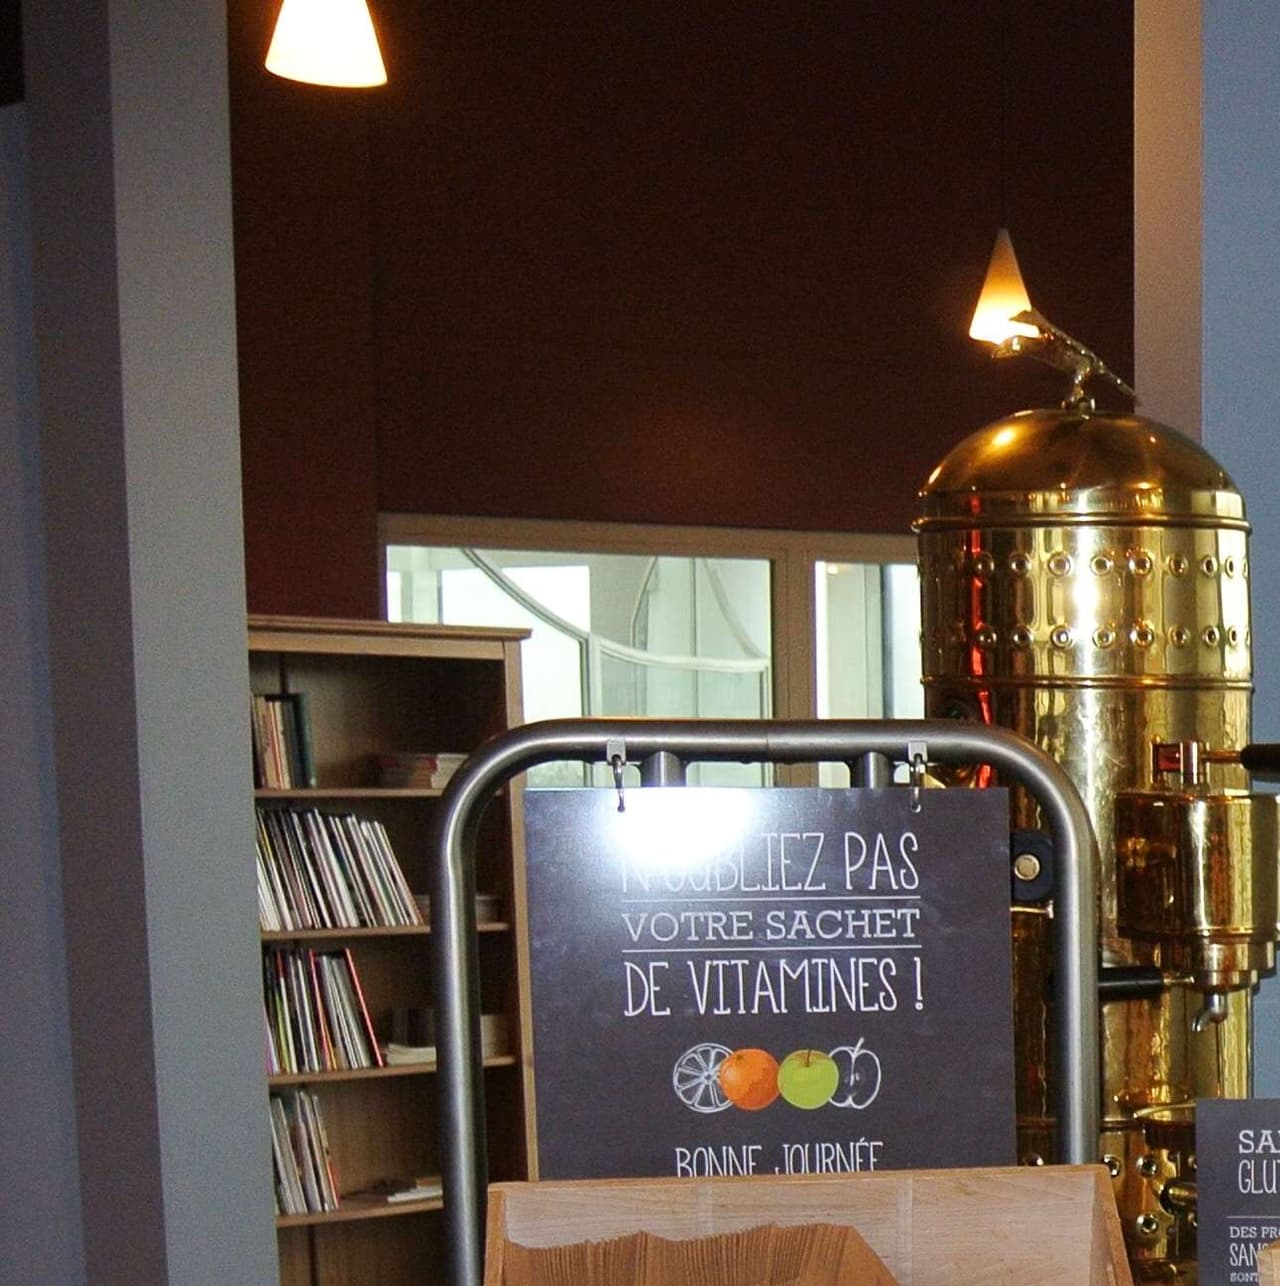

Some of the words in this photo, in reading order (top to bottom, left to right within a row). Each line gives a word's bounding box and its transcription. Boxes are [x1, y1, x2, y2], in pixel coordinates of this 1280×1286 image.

[845, 831, 919, 890] PAS
[623, 911, 753, 942] VOTRE
[767, 908, 920, 940] SACHET
[623, 961, 671, 1017] DE
[687, 958, 898, 1015] VITAMINES
[914, 957, 924, 1011] !
[675, 1145, 762, 1178] BONNE
[774, 1137, 883, 1176] JOURNÉE
[1229, 1226, 1257, 1238] DES
